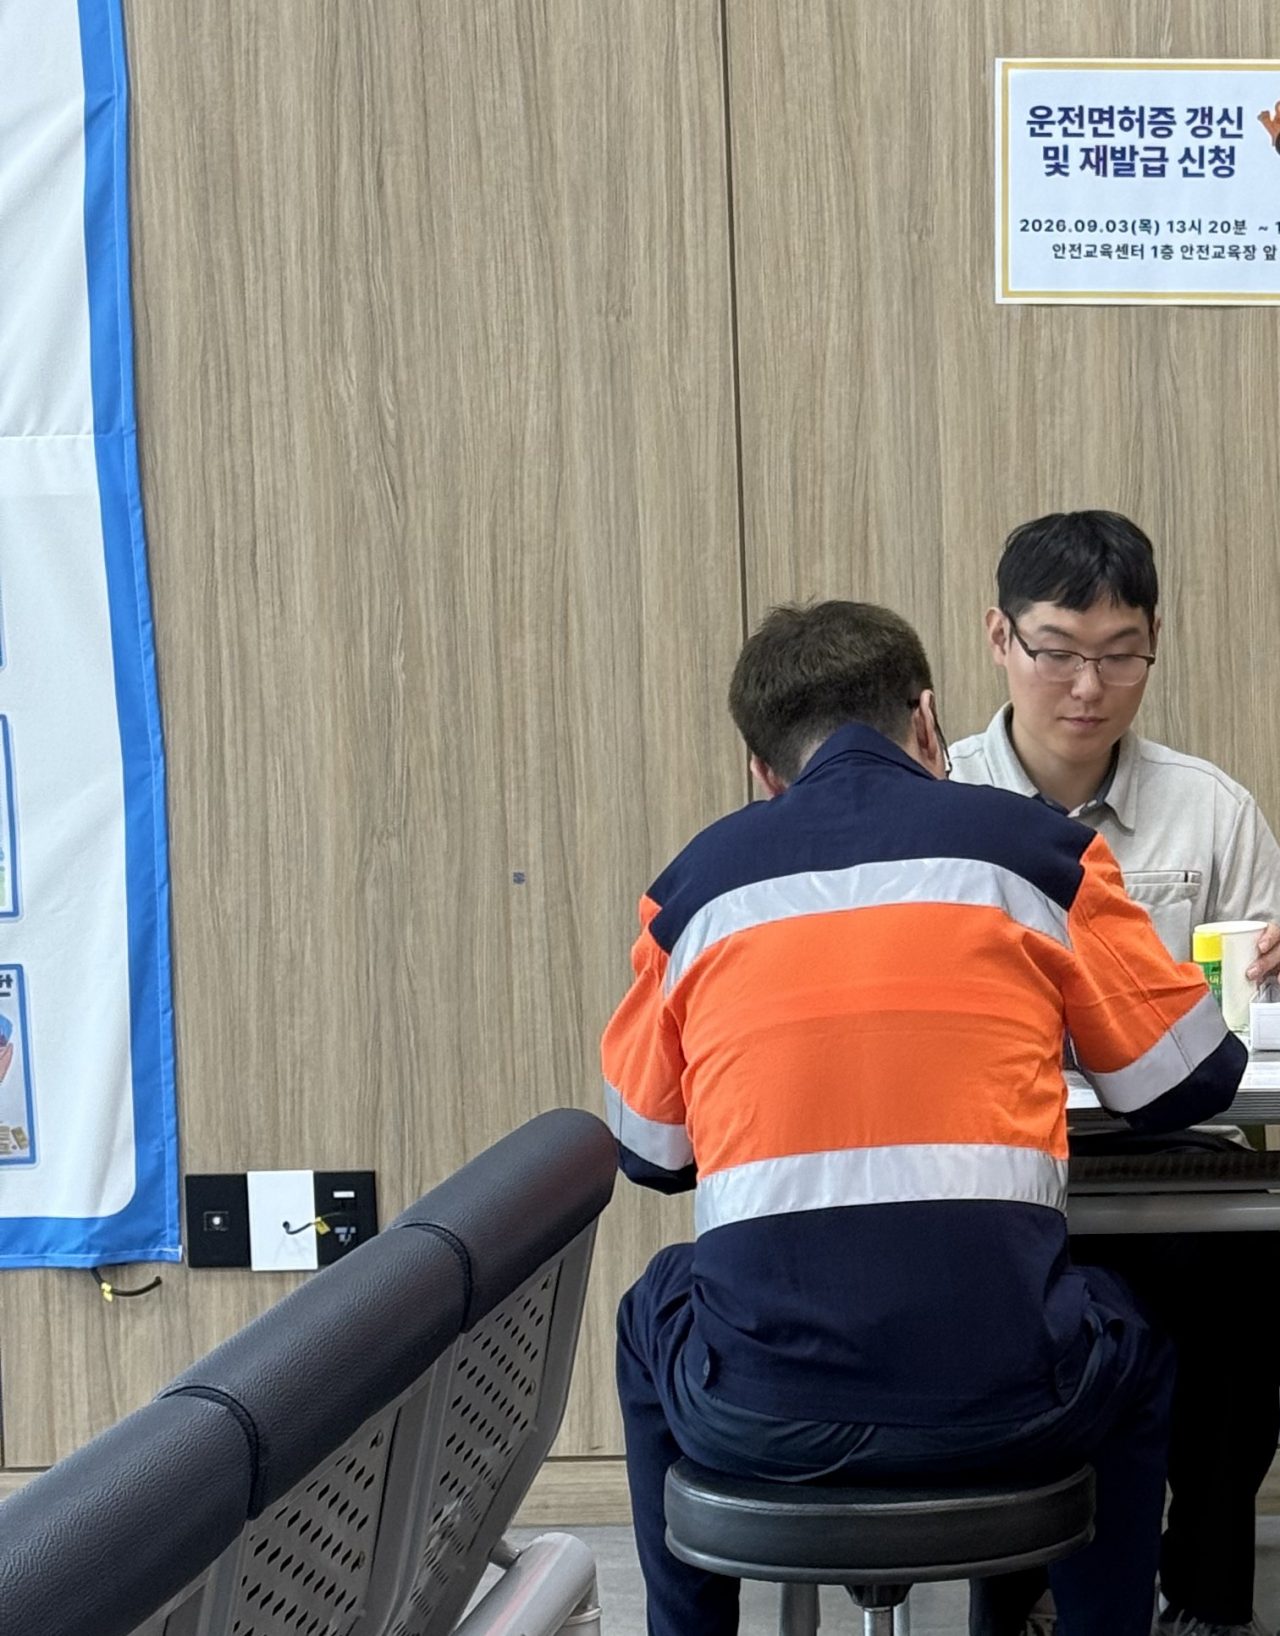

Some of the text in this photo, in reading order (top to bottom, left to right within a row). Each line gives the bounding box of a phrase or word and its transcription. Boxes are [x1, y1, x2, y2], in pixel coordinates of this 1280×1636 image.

[1027, 105, 1243, 139] 운전면허증 갱신
[1043, 145, 1235, 178] 및 재발급 신청
[1020, 219, 1159, 236] 2026.09.03(목)
[1167, 219, 1201, 234] 13시
[1209, 220, 1246, 235] 20분
[1052, 243, 1277, 260] 안전교육센터 1층 안전교육장 앞
